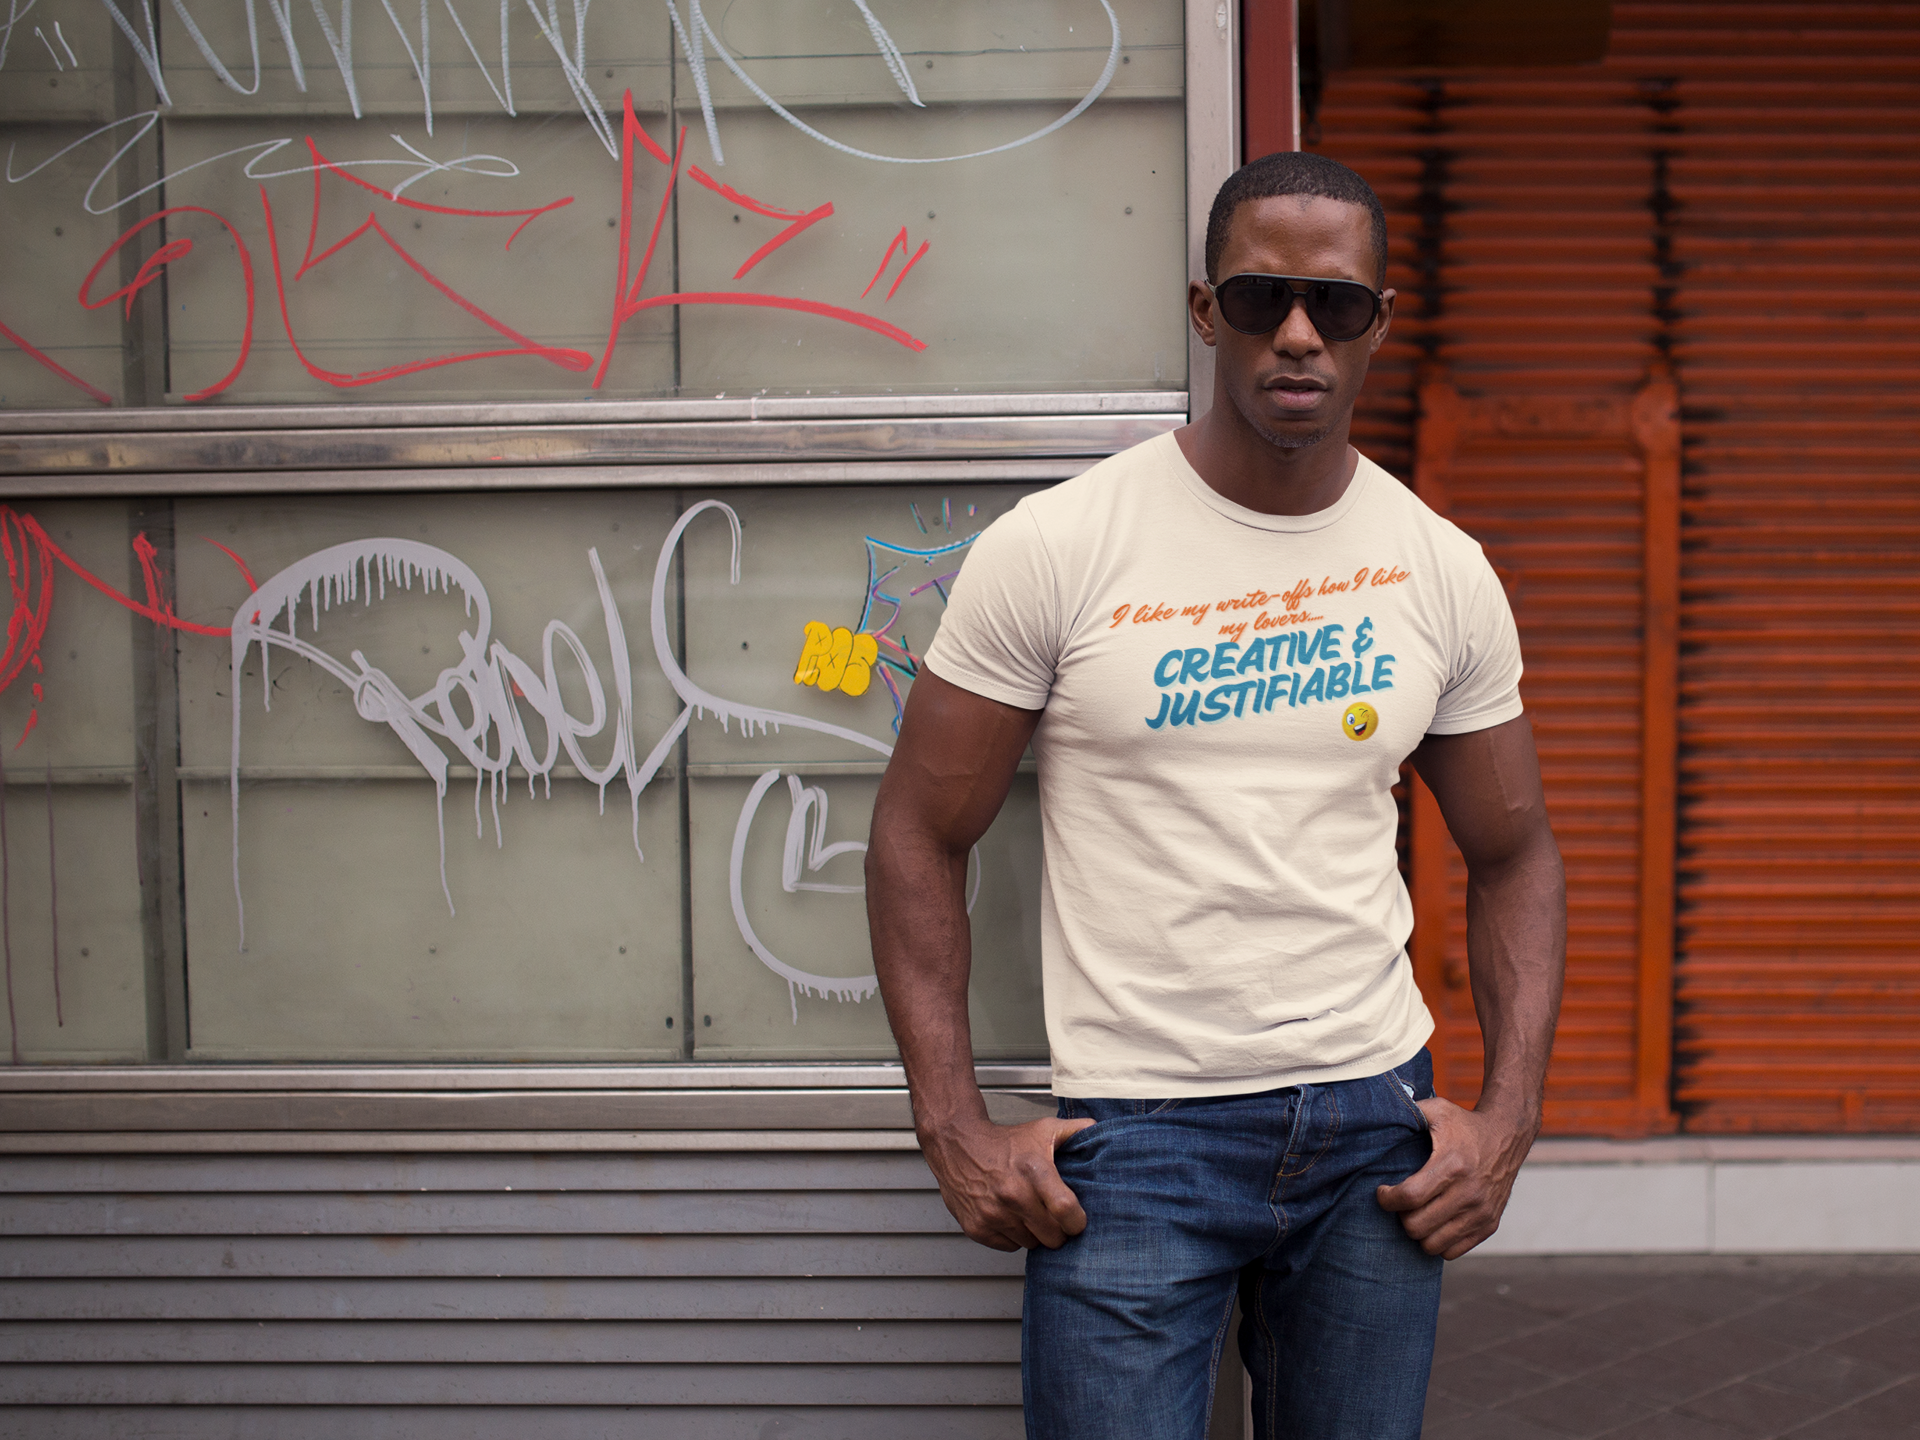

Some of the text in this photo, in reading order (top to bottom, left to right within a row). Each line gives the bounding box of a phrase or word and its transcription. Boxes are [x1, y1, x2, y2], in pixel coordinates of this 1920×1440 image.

[1109, 565, 1411, 629] I like my write-offs how I like
[1153, 616, 1376, 689] CREATIVE &
[1217, 621, 1248, 643] my
[1144, 654, 1398, 732] JUSTIFIABLE
